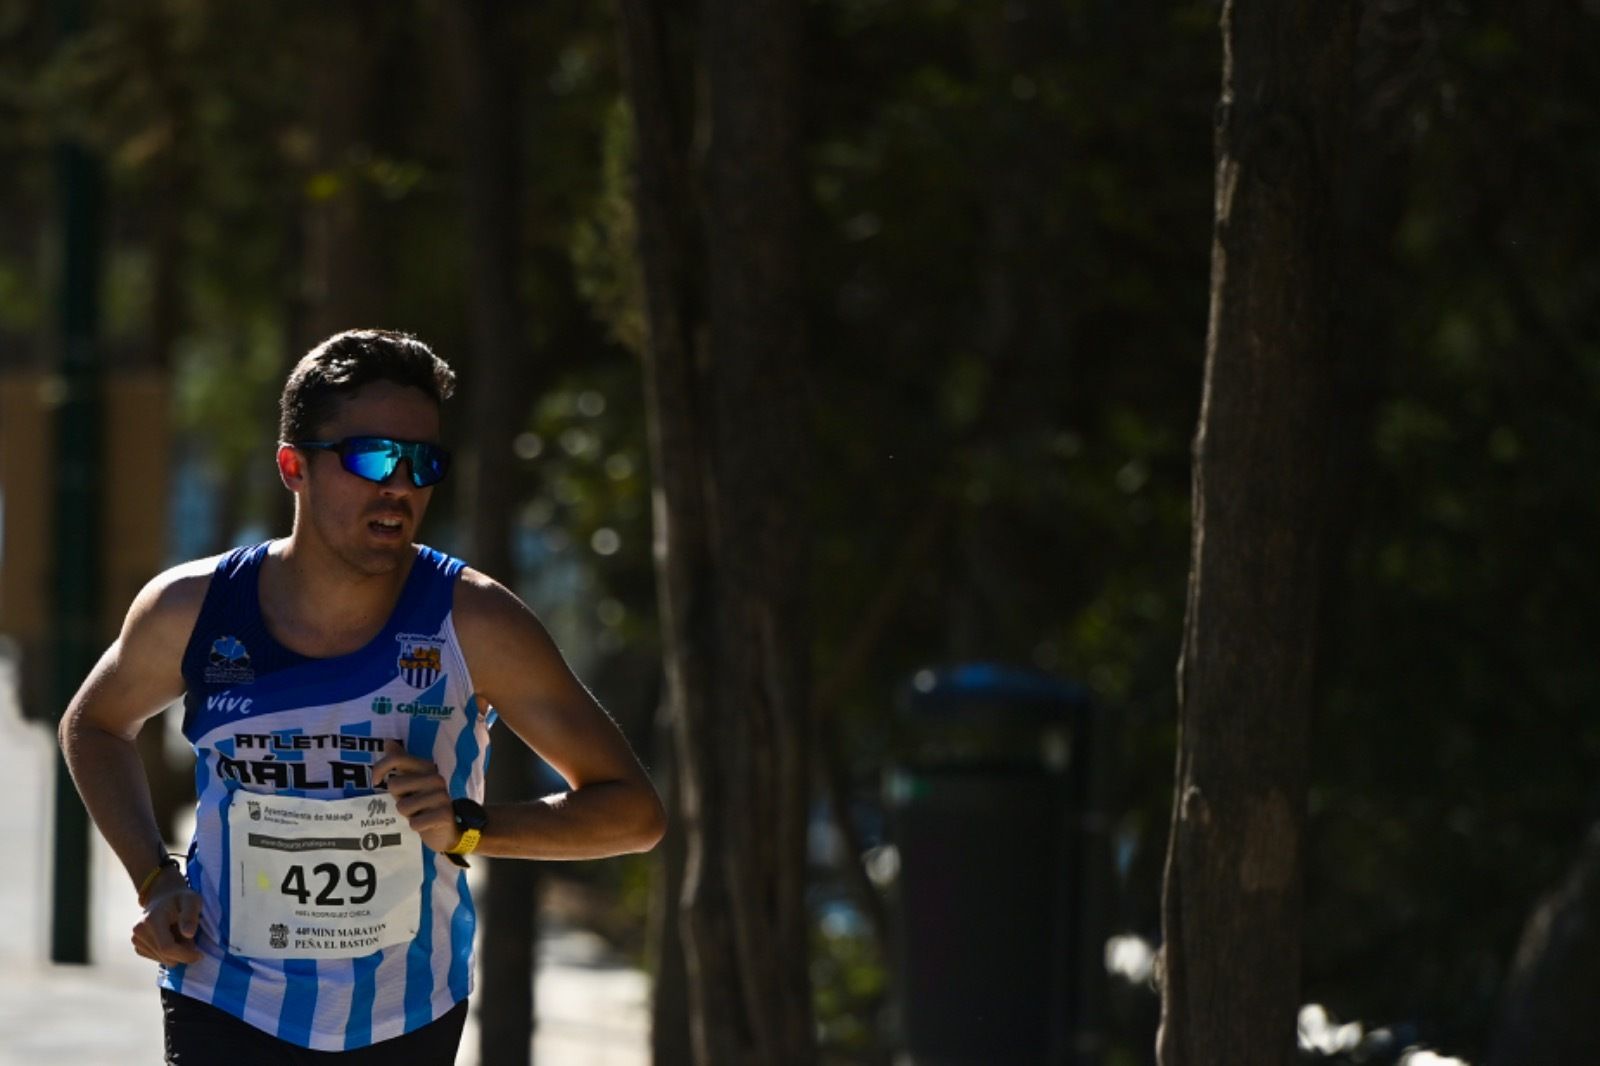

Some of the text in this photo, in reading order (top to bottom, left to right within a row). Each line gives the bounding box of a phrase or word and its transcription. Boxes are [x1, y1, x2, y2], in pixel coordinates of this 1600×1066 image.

[397, 701, 455, 717] cajamar
[235, 734, 403, 752] ATLETISM
[217, 753, 391, 790] MÁLA
[361, 817, 396, 828] Málaga
[281, 862, 377, 906] 429
[312, 927, 335, 937] MINI
[295, 938, 322, 949] PEÑA
[324, 940, 337, 949] EL
